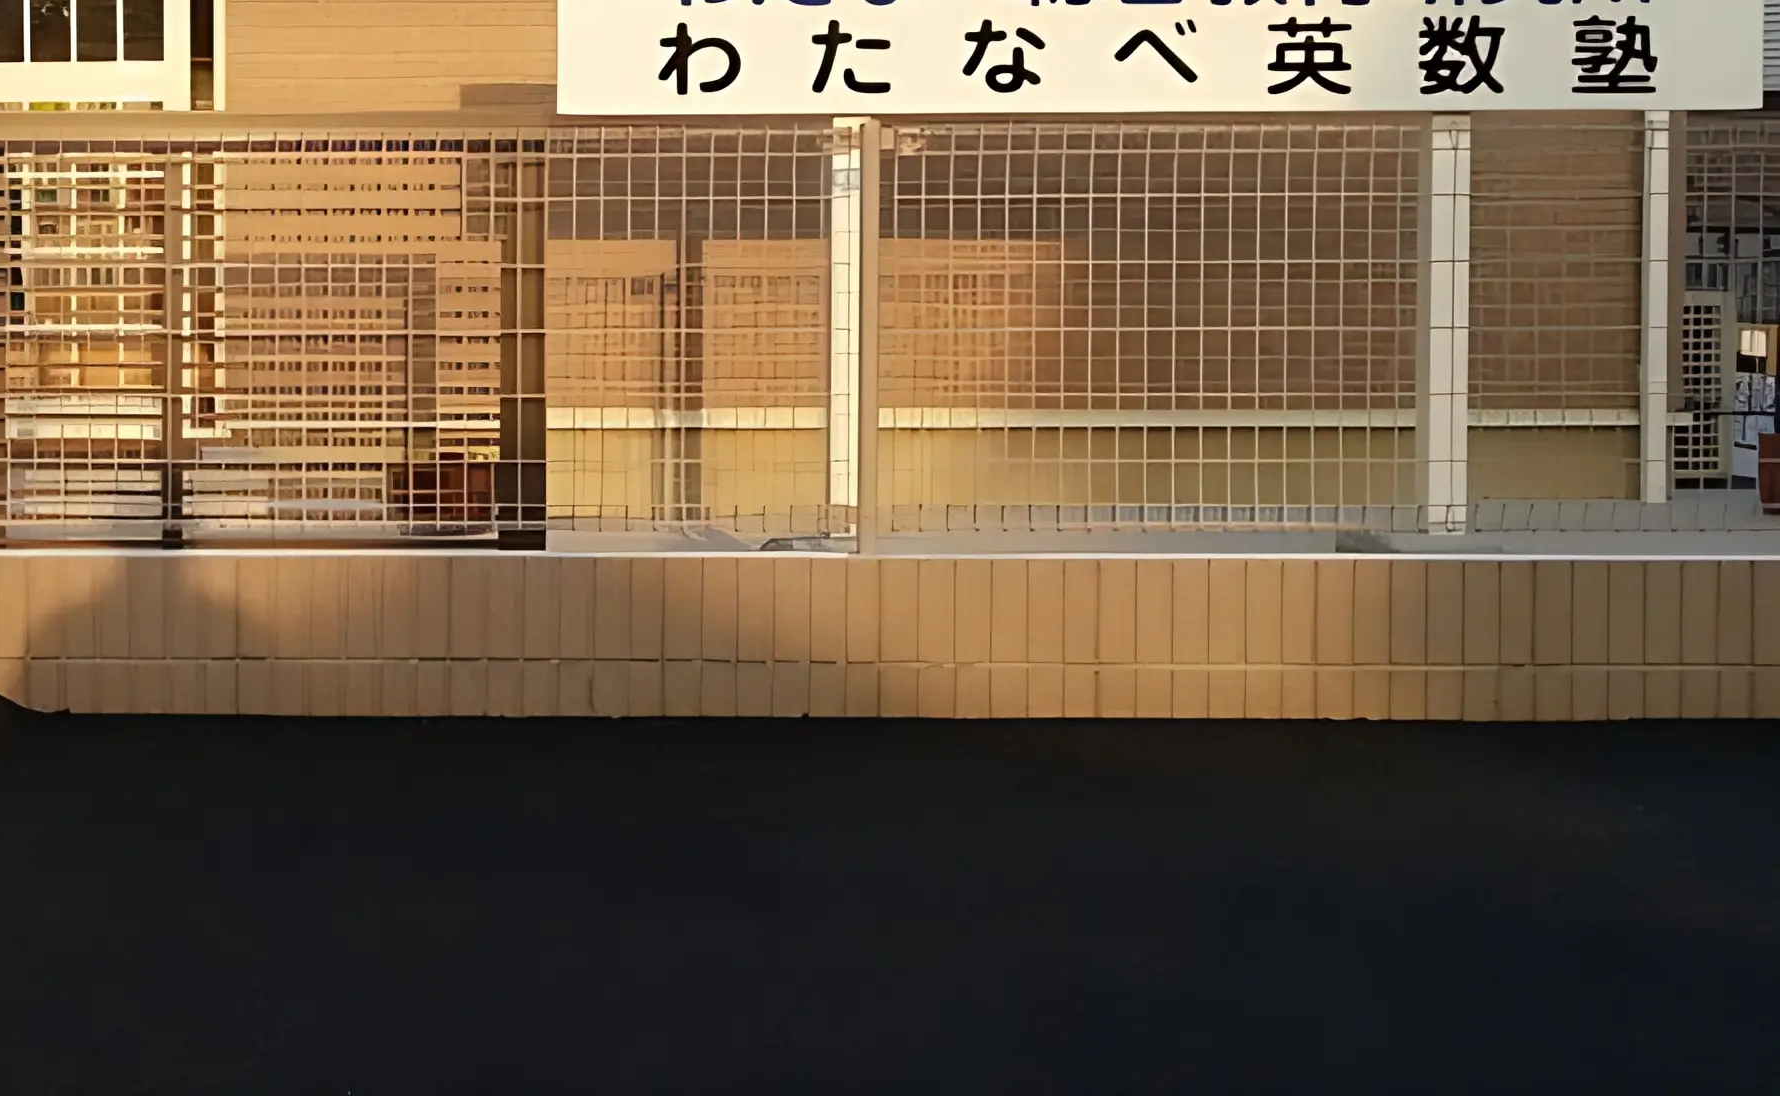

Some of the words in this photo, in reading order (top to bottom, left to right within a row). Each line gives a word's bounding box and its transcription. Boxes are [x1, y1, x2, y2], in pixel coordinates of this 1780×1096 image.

[659, 15, 1659, 95] わたなべ英数塾
